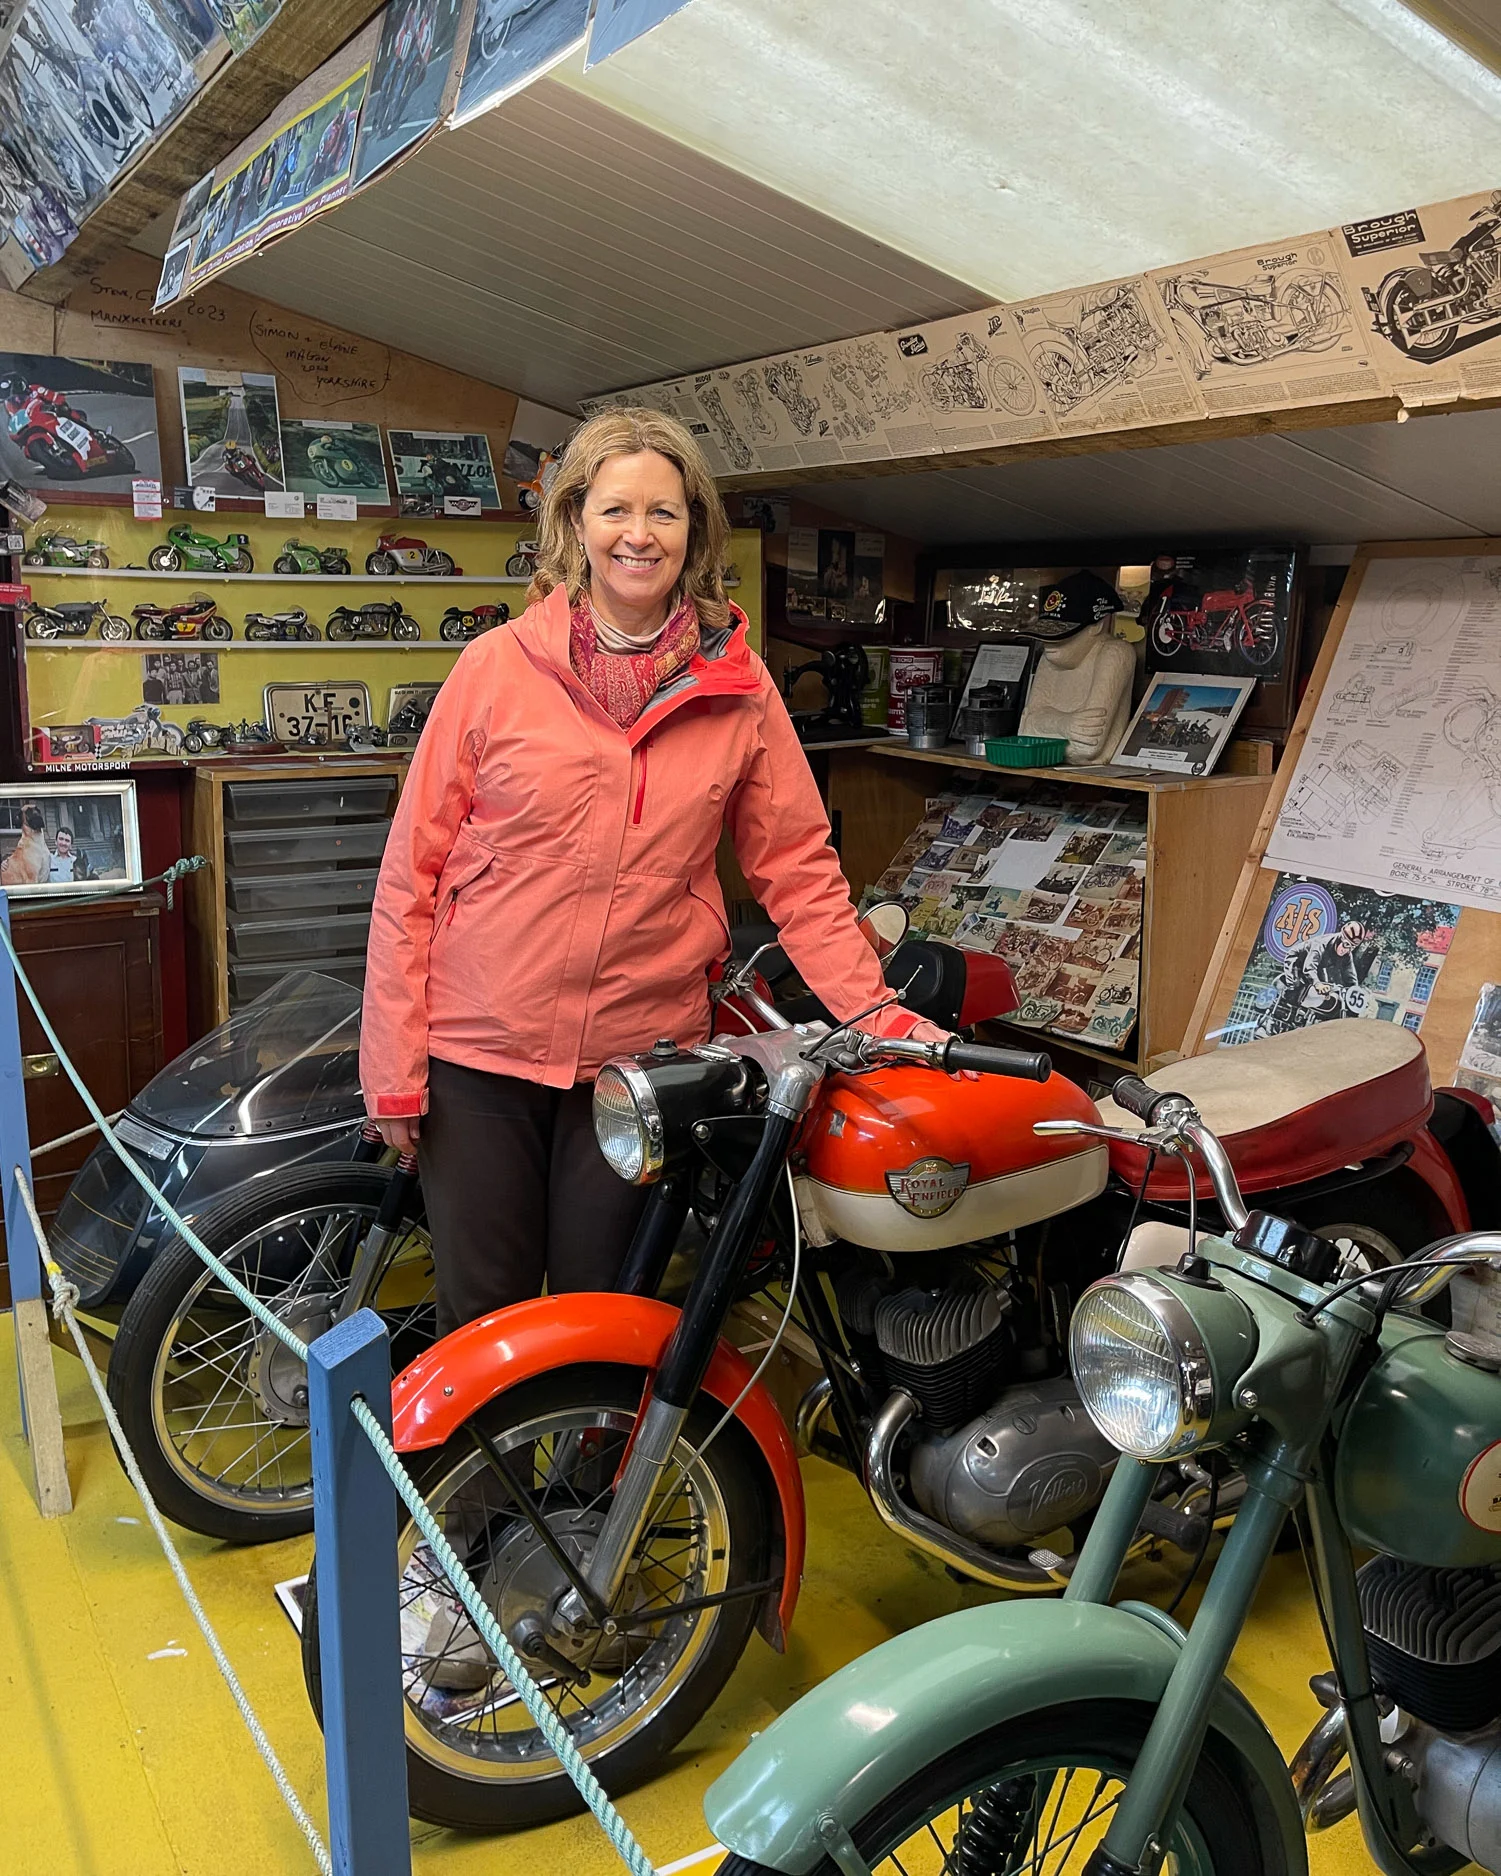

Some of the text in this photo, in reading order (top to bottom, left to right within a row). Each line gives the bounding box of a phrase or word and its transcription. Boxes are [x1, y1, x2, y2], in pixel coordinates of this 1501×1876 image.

[223, 235, 254, 262] Foundation
[255, 211, 303, 242] Commemorative
[304, 202, 318, 216] Year
[319, 183, 348, 207] Planner
[1343, 212, 1417, 236] Brough
[1351, 224, 1416, 244] Superior
[1257, 252, 1298, 266] Brough
[1262, 259, 1298, 271] Superior
[187, 300, 226, 321] 2023
[254, 324, 299, 340] SIMON
[316, 375, 377, 389] YORKSHIRE
[409, 550, 416, 560] 2
[463, 616, 473, 626] 34
[45, 761, 131, 773] MILNE MOTORSPORT
[1390, 869, 1410, 880] BORE
[1446, 880, 1477, 891] STROKE
[1392, 862, 1496, 885] GENERAL ARRANGEMENT OF
[1349, 990, 1365, 1009] 55
[900, 1177, 945, 1193] ROYAL
[910, 1188, 960, 1207] ENFIELD
